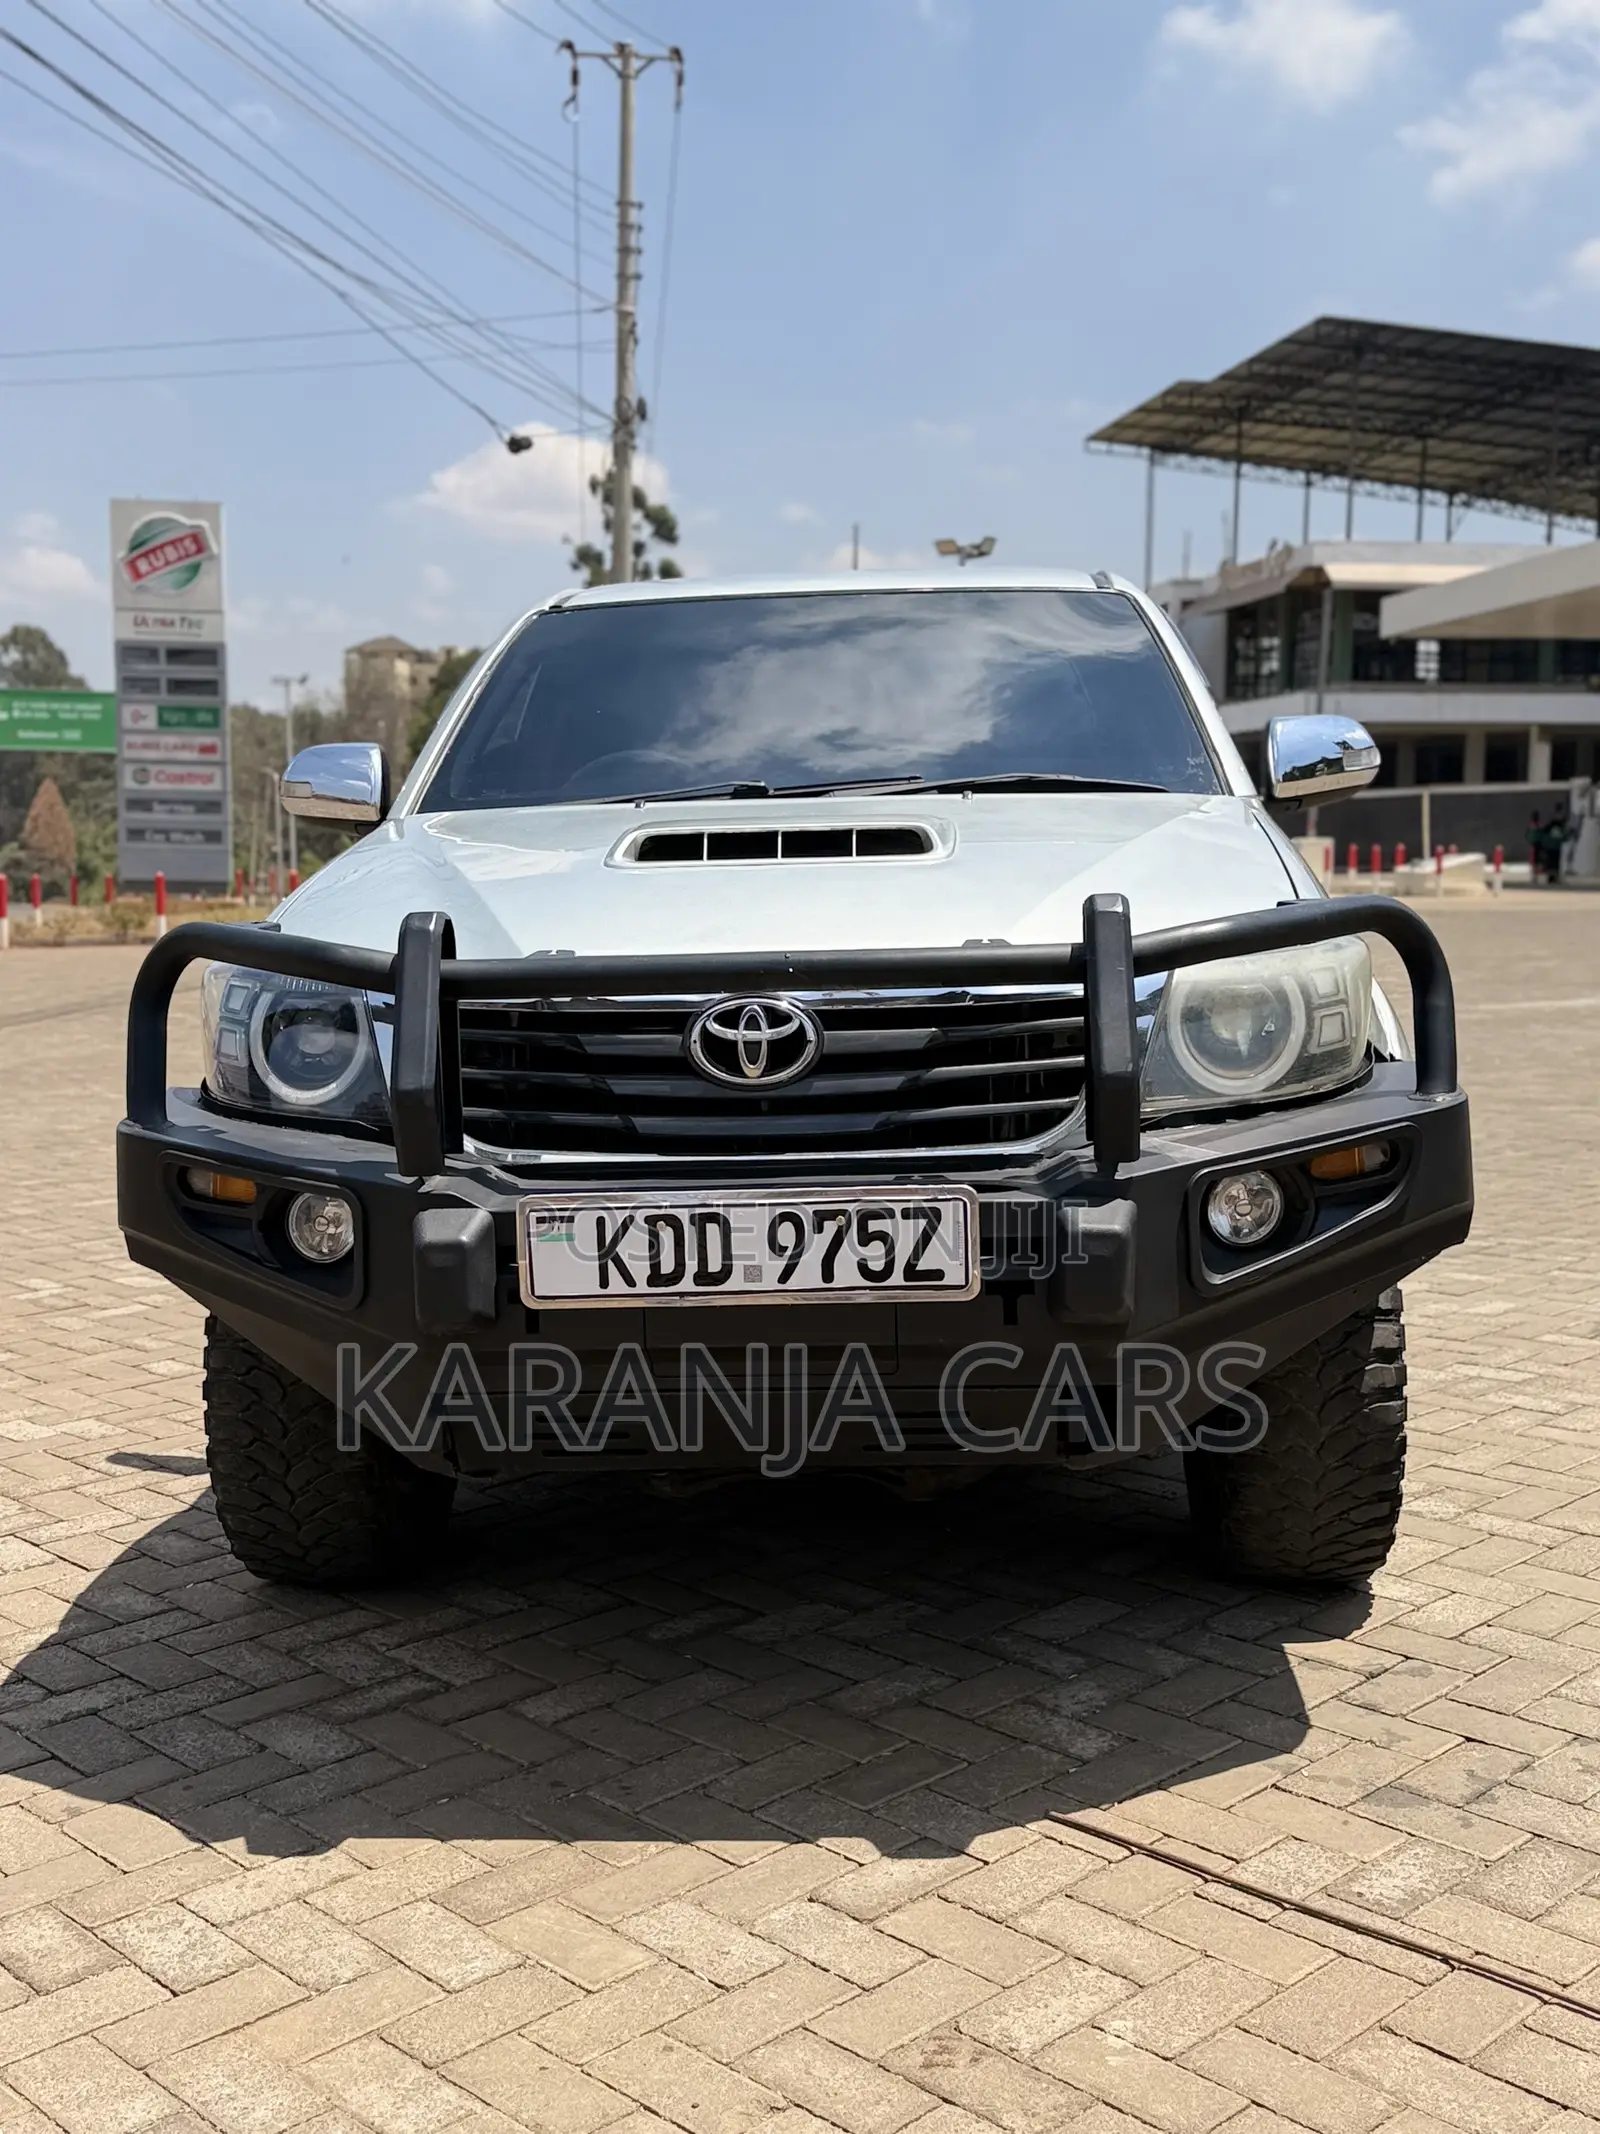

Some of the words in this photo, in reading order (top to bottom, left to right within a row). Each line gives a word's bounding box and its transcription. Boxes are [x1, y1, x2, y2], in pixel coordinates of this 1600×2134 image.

[135, 536, 199, 575] RUBIS
[154, 769, 215, 786] Castrol
[596, 1211, 734, 1290] KDD
[766, 1206, 946, 1285] 975Z
